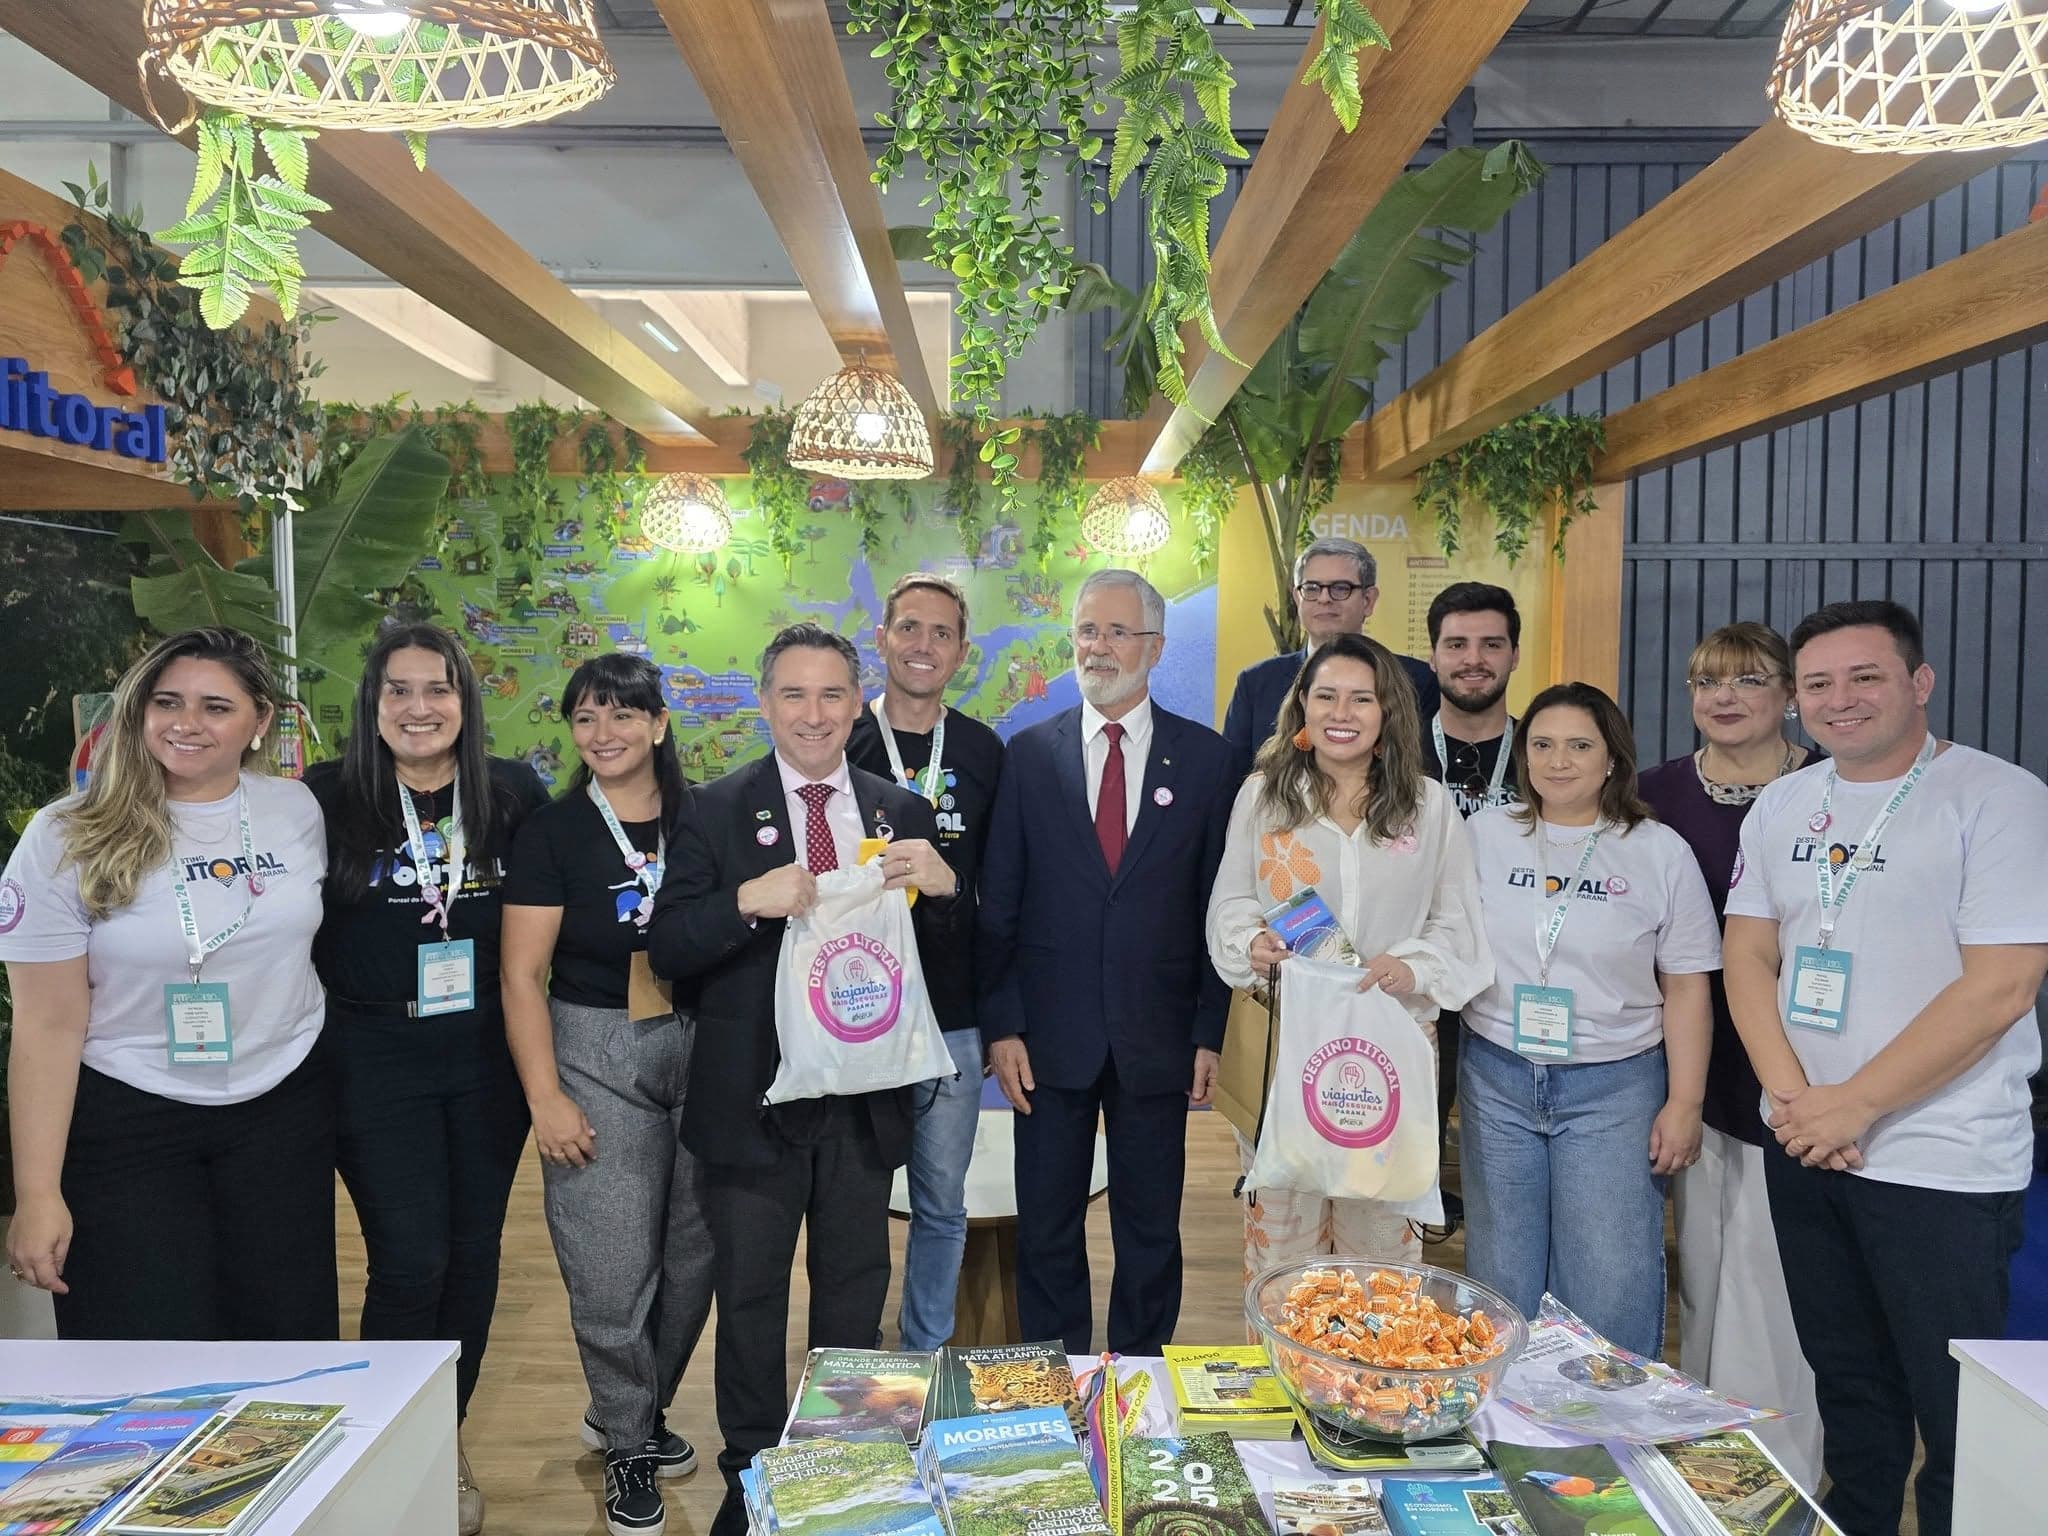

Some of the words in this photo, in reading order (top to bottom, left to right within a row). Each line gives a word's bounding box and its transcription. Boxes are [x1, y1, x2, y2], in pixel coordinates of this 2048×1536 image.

[0, 357, 166, 462] litoral
[1310, 514, 1408, 538] GENDA
[1795, 836, 1817, 844] DESTI
[181, 855, 205, 865] STINO
[809, 938, 850, 988] DESTINO
[853, 932, 901, 977] LITORAL
[831, 977, 887, 1005] viajantes
[1302, 1038, 1352, 1085] DESTINO
[1355, 1039, 1400, 1093] LITORAL
[1322, 1086, 1382, 1109] viajantes
[958, 1353, 991, 1361] MATA
[969, 1347, 1005, 1355] GRANDE
[1005, 1345, 1041, 1353] RESERVA
[823, 1360, 855, 1368] MATA
[837, 1355, 871, 1363] GRANDE
[1134, 1389, 1145, 1407] DO
[1105, 1392, 1115, 1424] SENHORA
[943, 1419, 1067, 1446] MORRETES
[1108, 1425, 1116, 1438] DO
[1109, 1439, 1118, 1465] ROCIO
[768, 1459, 816, 1475] nature
[806, 1463, 841, 1477] Your
[769, 1471, 802, 1484] best
[1110, 1468, 1120, 1522] PADROEIRA
[1034, 1509, 1056, 1520] Tu
[1058, 1505, 1099, 1518] mejor
[1028, 1516, 1082, 1530] destino
[1084, 1513, 1104, 1524] de
